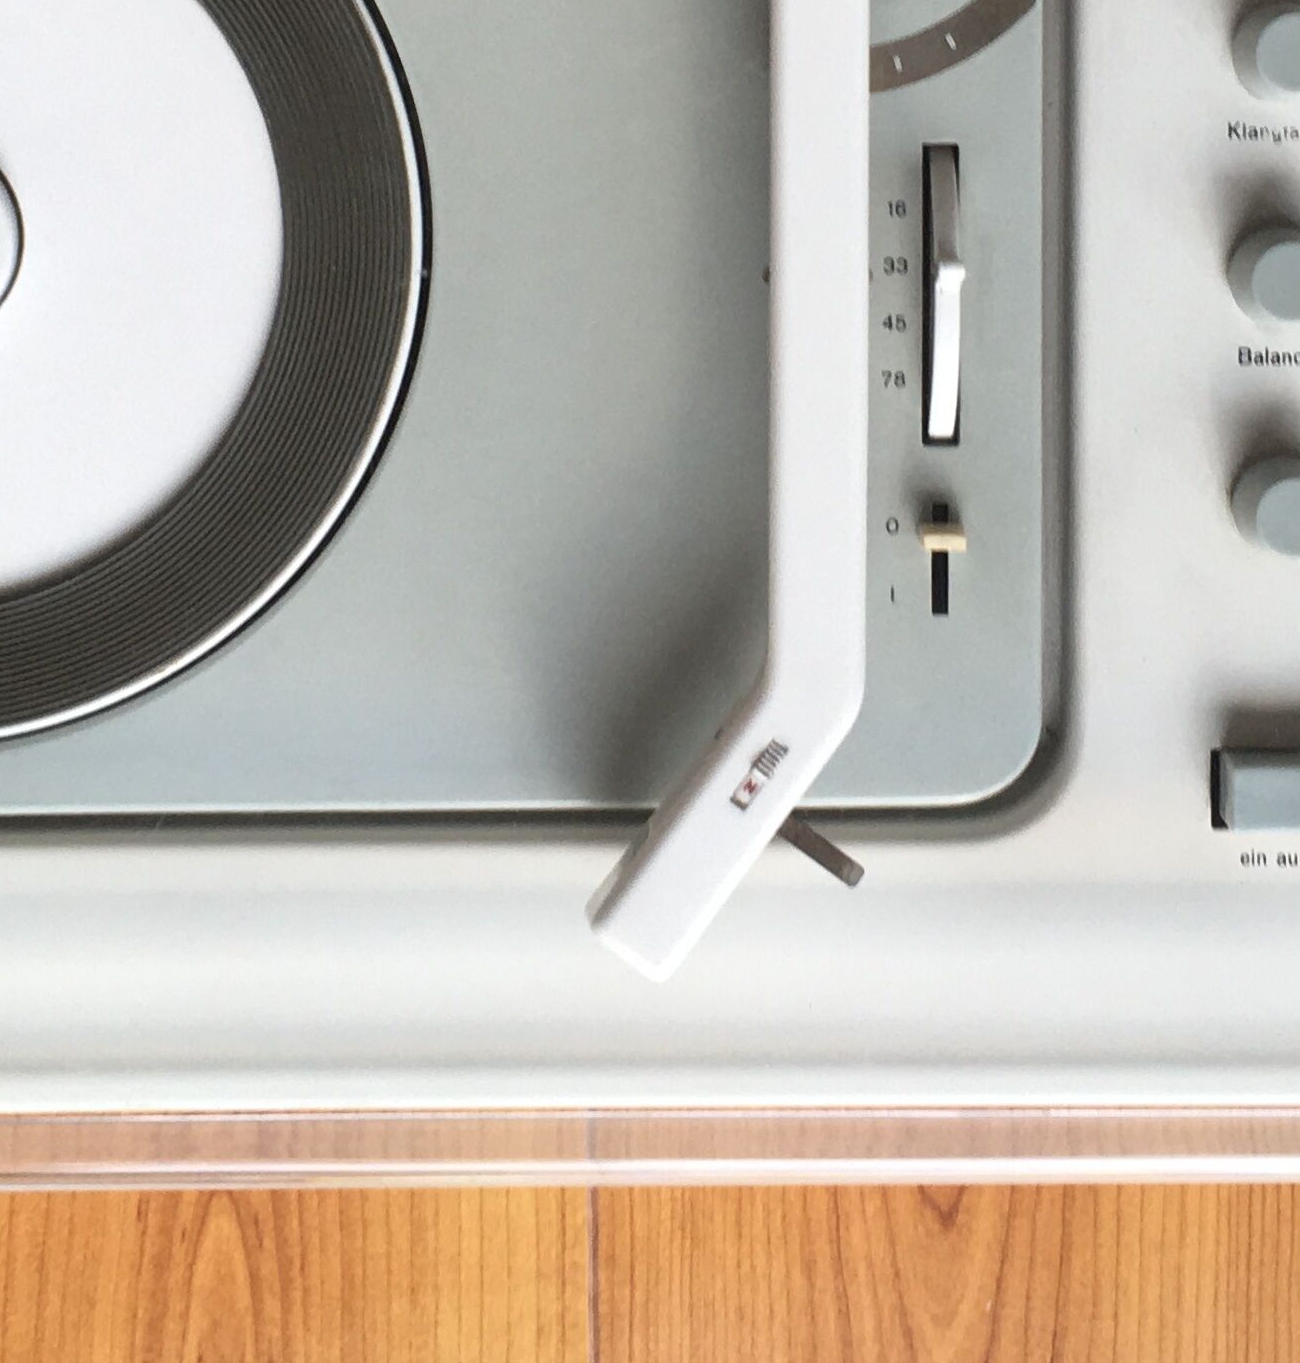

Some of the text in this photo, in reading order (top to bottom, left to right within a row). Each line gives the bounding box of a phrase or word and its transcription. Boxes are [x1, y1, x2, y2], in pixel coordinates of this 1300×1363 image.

[887, 199, 907, 219] 16
[883, 256, 909, 276] 33
[881, 314, 907, 333] 45
[881, 370, 906, 389] 78
[1240, 848, 1268, 867] ein
